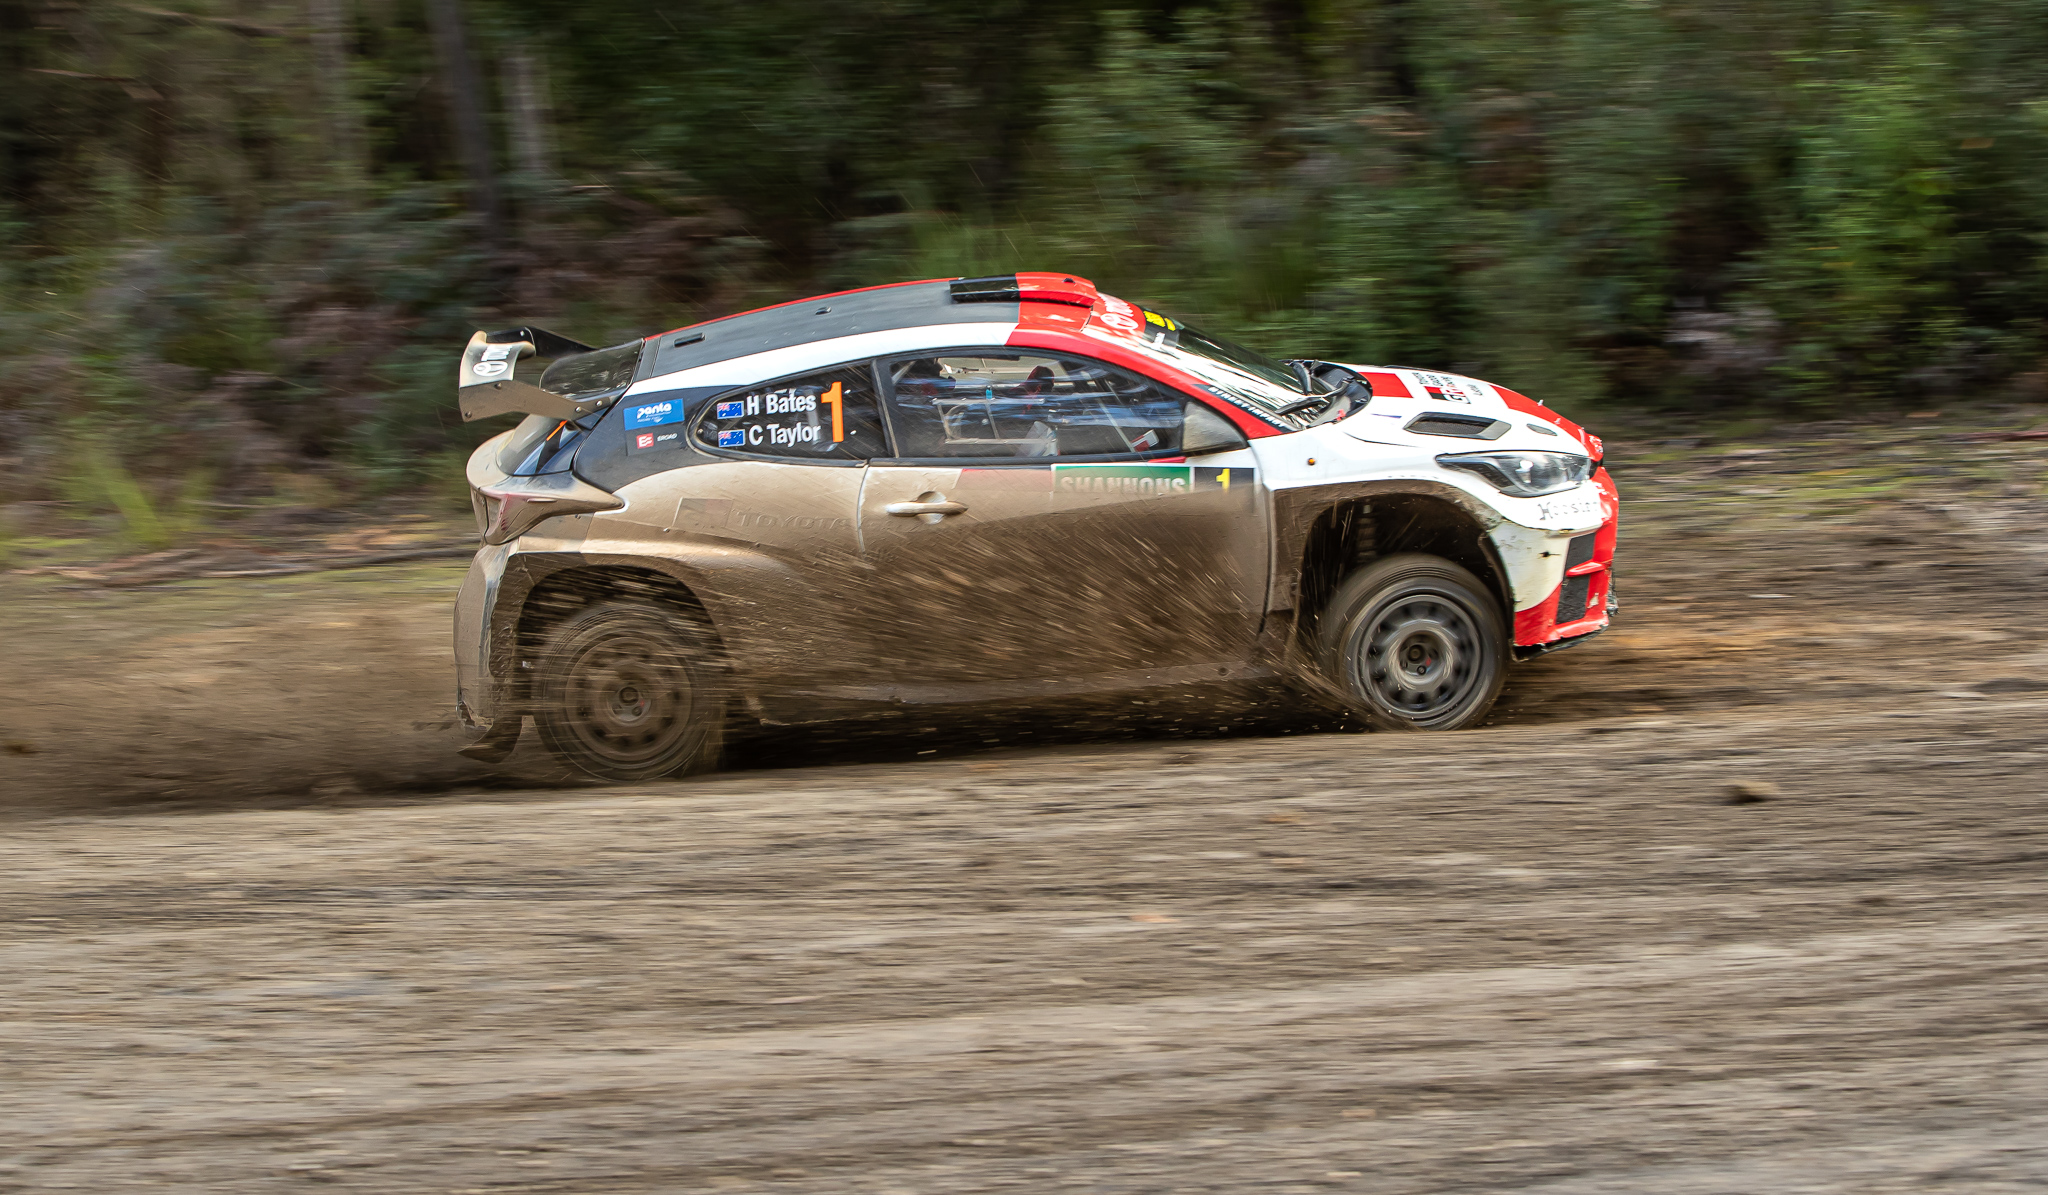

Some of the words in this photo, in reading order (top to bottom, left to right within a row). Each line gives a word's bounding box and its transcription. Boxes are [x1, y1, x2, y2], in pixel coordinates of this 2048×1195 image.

[746, 394, 760, 416] H
[766, 391, 817, 414] Bates
[820, 381, 844, 443] 1
[748, 424, 764, 446] C
[766, 422, 822, 448] Taylor
[1215, 468, 1231, 493] 1
